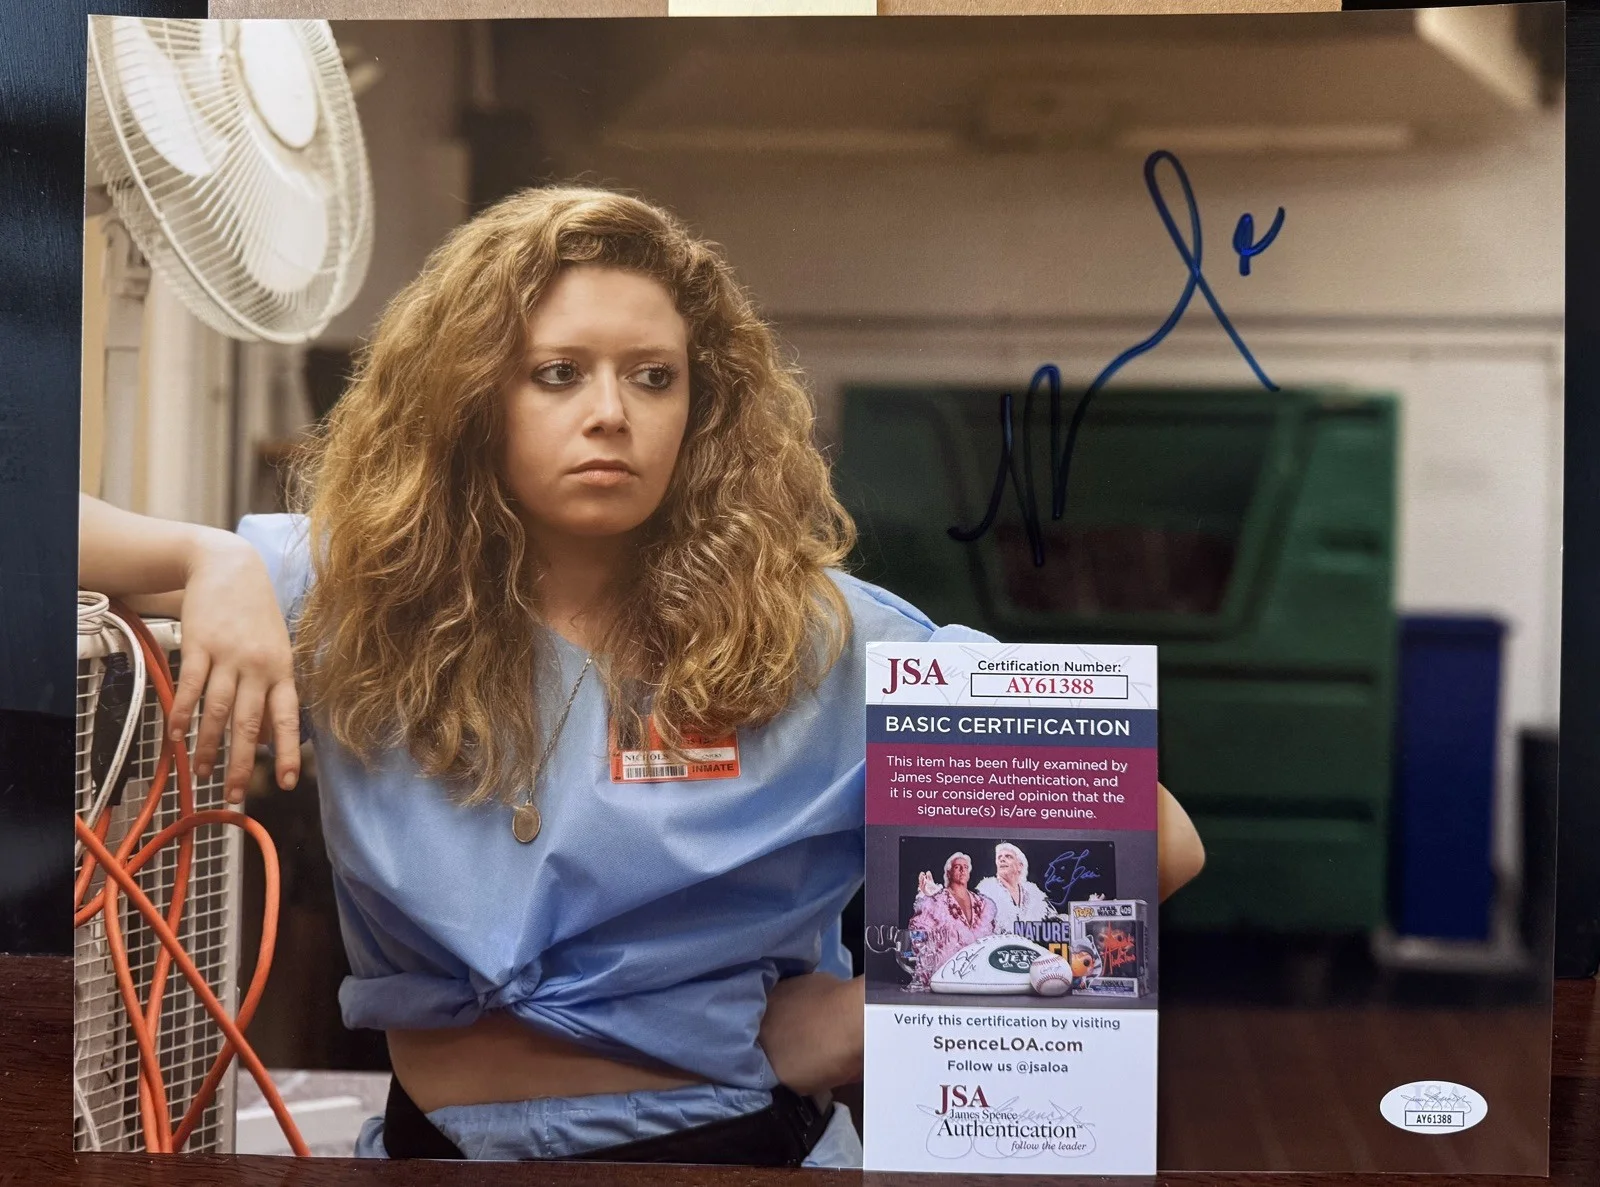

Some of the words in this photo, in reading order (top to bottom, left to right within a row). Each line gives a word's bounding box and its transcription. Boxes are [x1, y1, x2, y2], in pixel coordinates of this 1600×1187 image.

[977, 660, 1061, 672] Certification
[1064, 661, 1122, 673] Number:
[882, 658, 948, 695] JSA
[1006, 677, 1094, 694] AY61388
[885, 716, 951, 733] BASIC
[958, 717, 1130, 736] CERTIFICATION
[692, 763, 734, 772] INMATE
[887, 755, 913, 767] This
[916, 756, 945, 768] item
[949, 757, 971, 768] has
[975, 757, 1008, 769] been
[1012, 757, 1040, 772] fully
[1043, 758, 1107, 771] examined
[1111, 760, 1128, 773] by
[890, 772, 932, 784] James
[935, 772, 984, 787] Spence
[988, 773, 1090, 788] Authentication,
[1093, 775, 1118, 787] and
[890, 787, 898, 798] it
[902, 788, 912, 799] is
[916, 789, 938, 799] our
[942, 788, 1015, 801] considered
[1018, 790, 1068, 803] opinion
[1072, 791, 1099, 803] that
[1102, 791, 1125, 803] the
[917, 804, 996, 818] signature(s)
[1000, 804, 1037, 818] is/are
[1040, 807, 1097, 820] genuine.
[1014, 921, 1070, 942] NATURE
[998, 951, 1039, 964] JETS
[894, 1013, 935, 1027] Verify
[938, 1014, 962, 1027] this
[966, 1015, 1047, 1028] certification
[1051, 1016, 1068, 1030] by
[1072, 1017, 1120, 1031] visiting
[933, 1036, 1083, 1052] SpenceLOA.com
[947, 1060, 993, 1072] Follow
[997, 1062, 1012, 1072] us
[1016, 1060, 1069, 1074] @jsaloa
[935, 1084, 990, 1115] JSA
[950, 1109, 980, 1120] James
[982, 1109, 1018, 1121] Spence
[1416, 1115, 1452, 1124] AY61388
[1011, 1140, 1039, 1152] follow
[1041, 1141, 1056, 1151] the
[1058, 1141, 1087, 1151] leader
